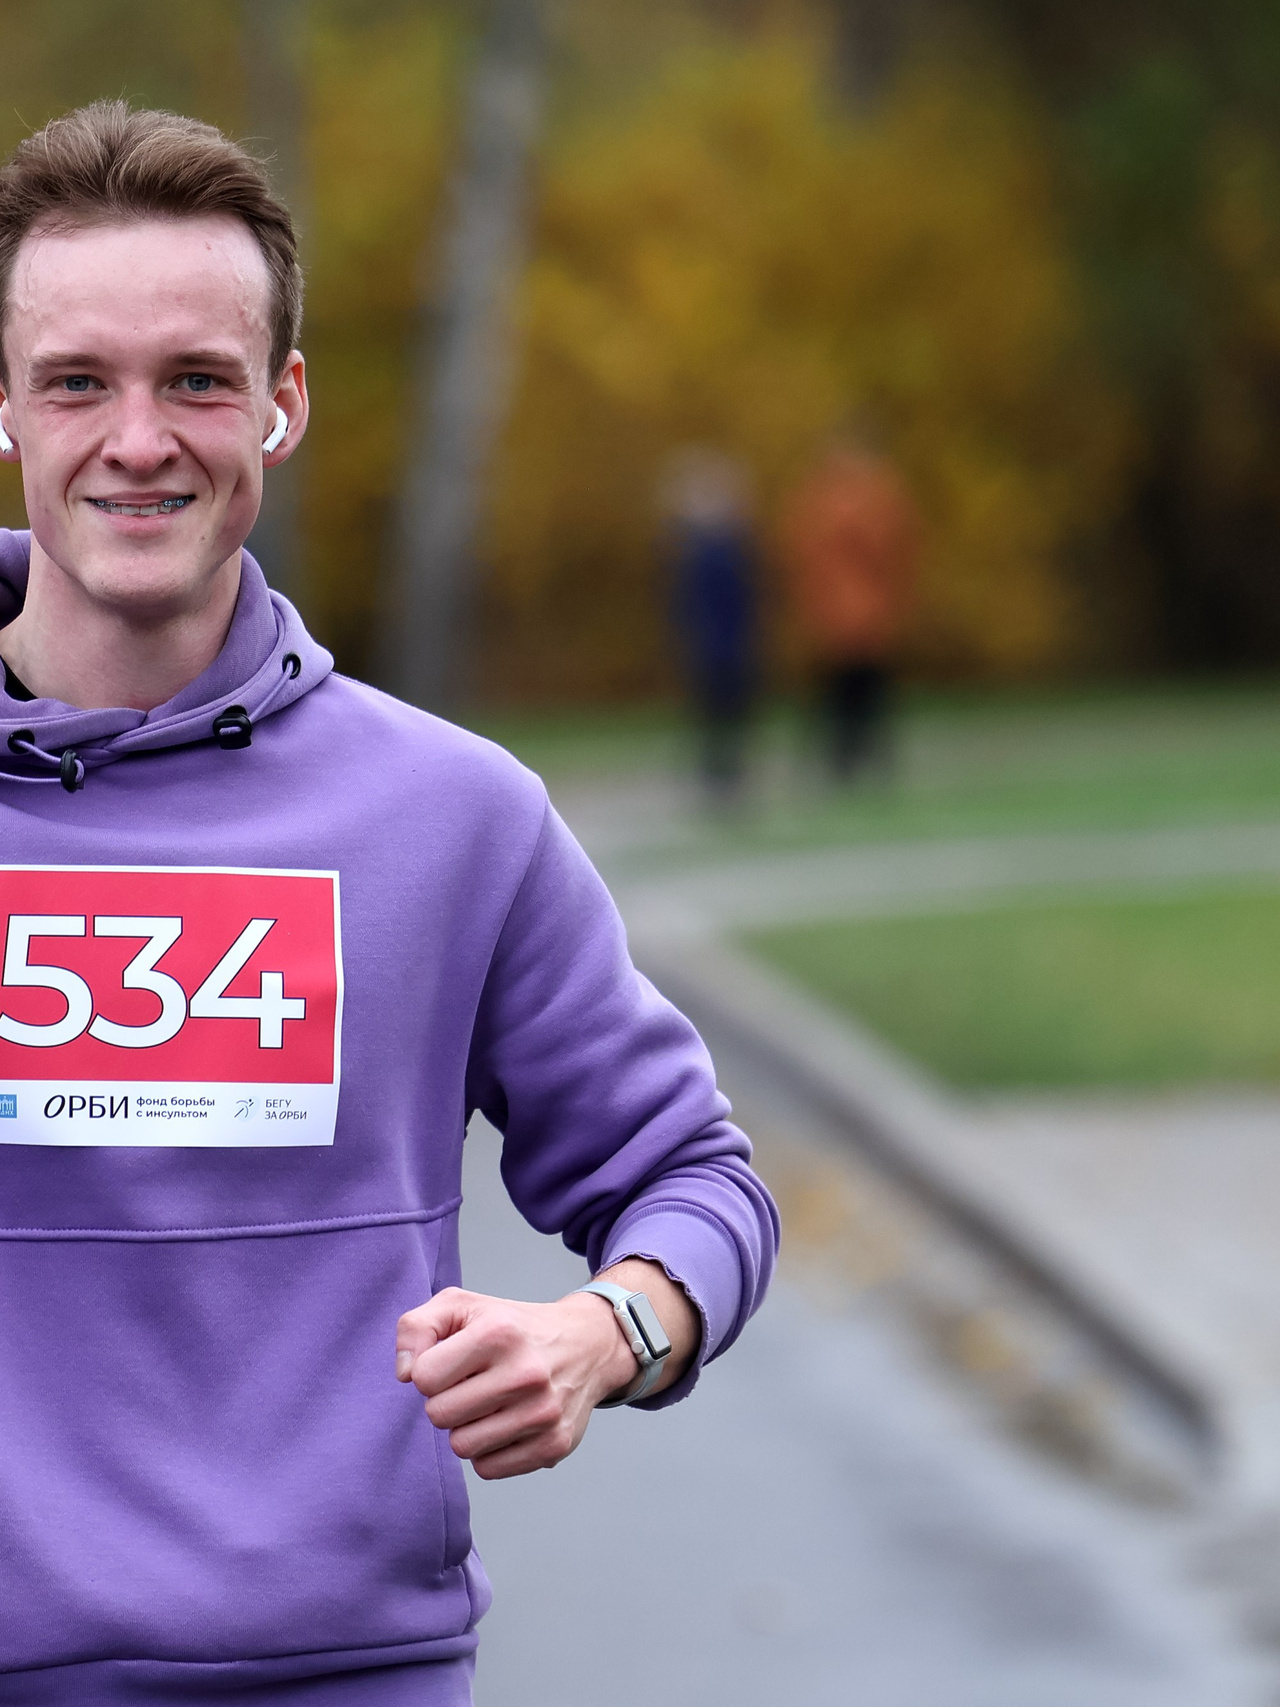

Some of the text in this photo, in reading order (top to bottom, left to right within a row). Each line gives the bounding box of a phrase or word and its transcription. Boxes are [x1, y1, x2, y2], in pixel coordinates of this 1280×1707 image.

[43, 1094, 129, 1119] ОРБИ
[136, 1096, 215, 1107] фонд борьбы
[265, 1099, 292, 1108] БЕГУ
[136, 1110, 208, 1119] с инсультом
[264, 1110, 308, 1120] ЗА ОРБИ
